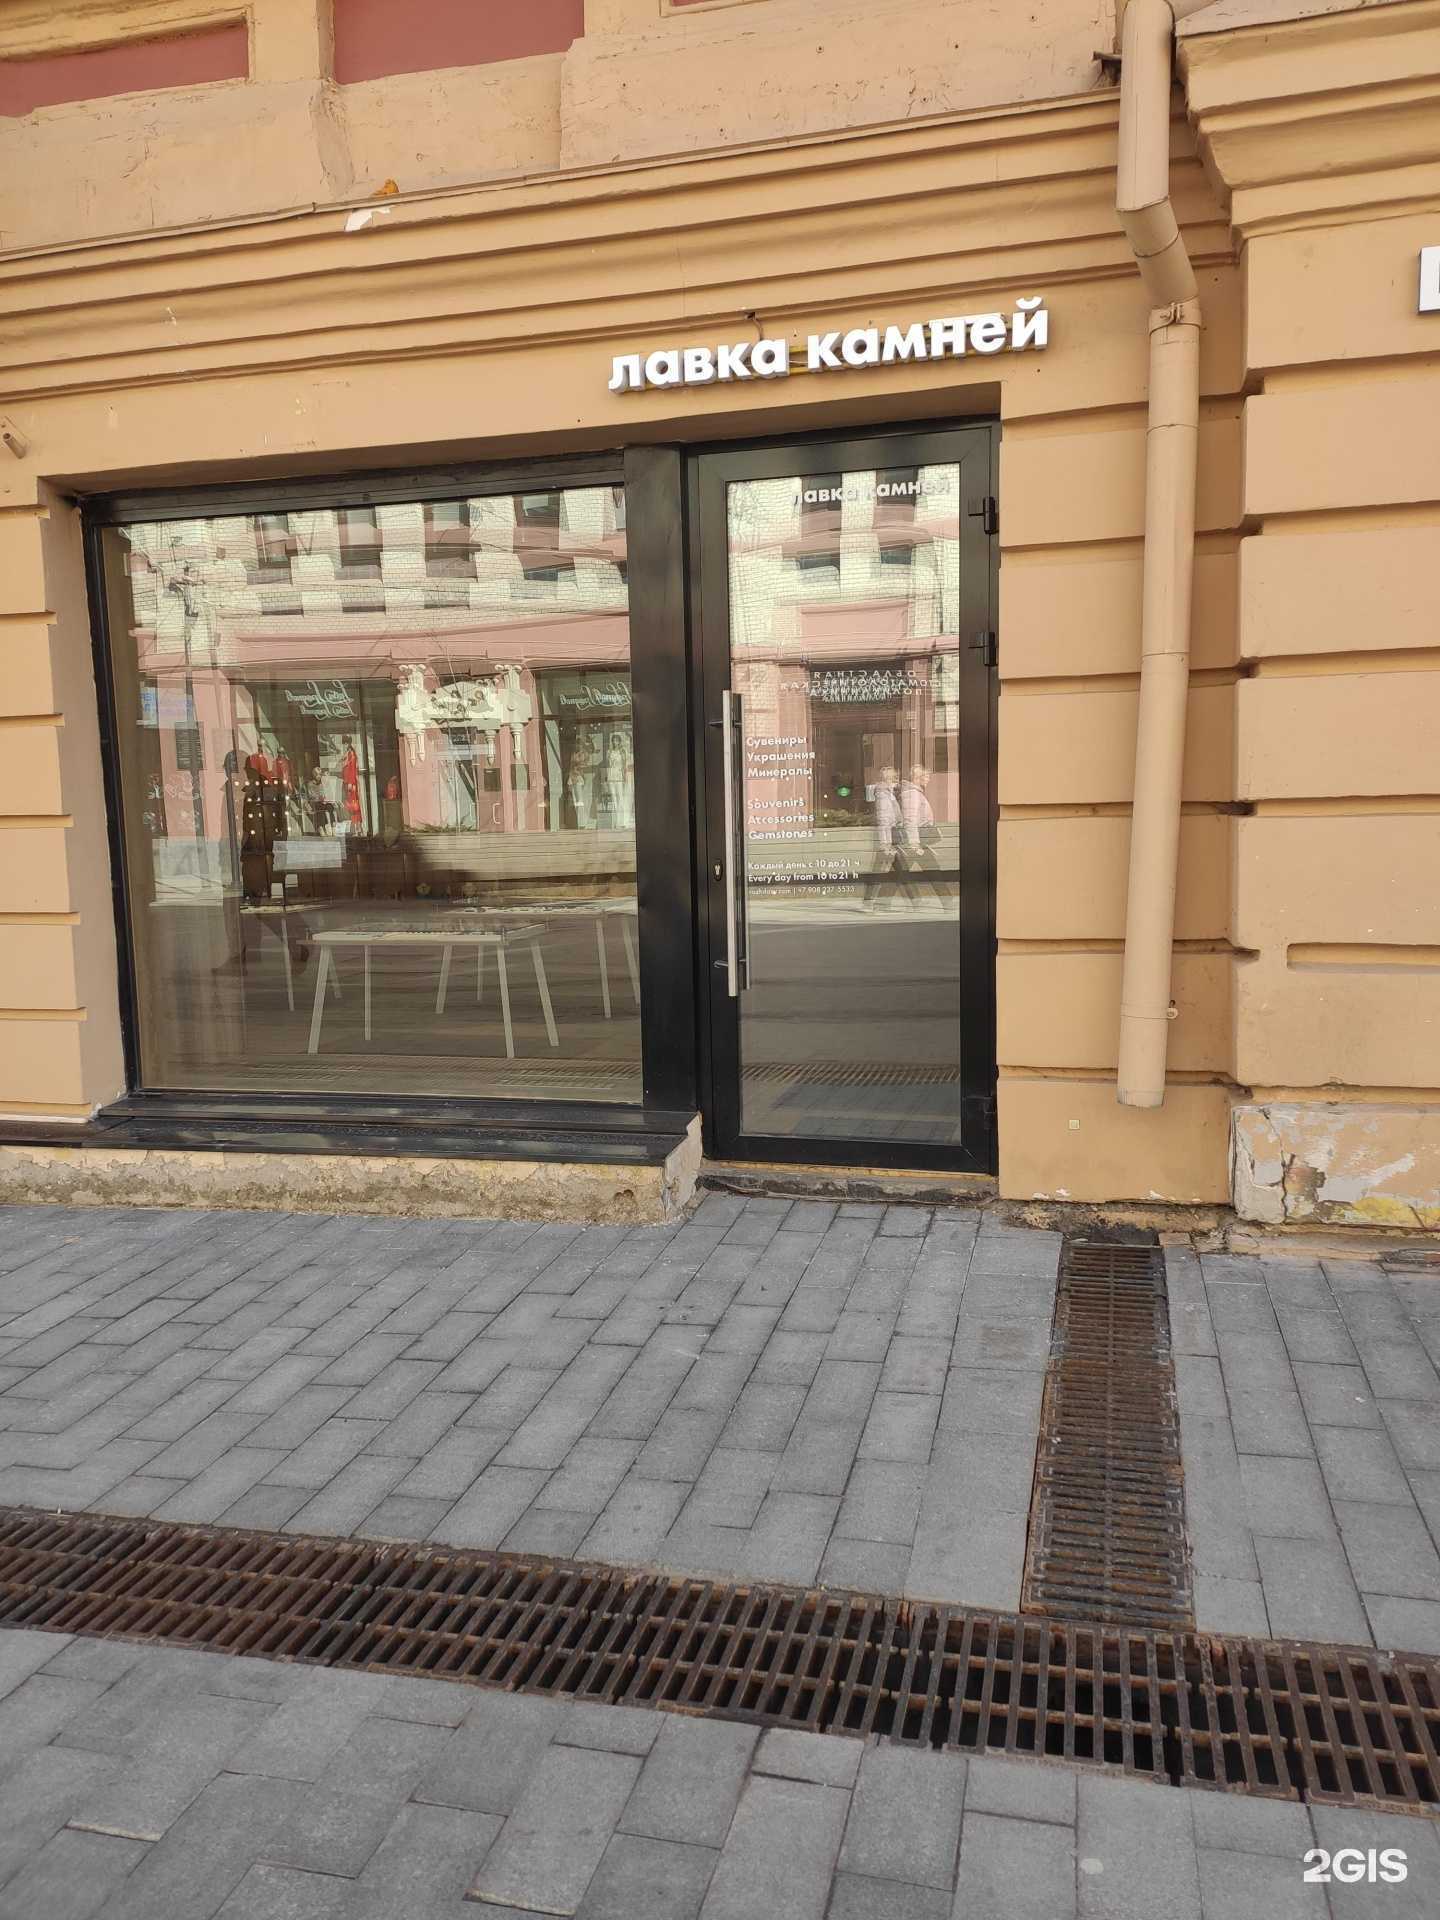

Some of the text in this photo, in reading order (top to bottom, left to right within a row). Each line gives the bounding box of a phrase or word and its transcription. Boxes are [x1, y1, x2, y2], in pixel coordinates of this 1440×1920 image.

[608, 296, 1049, 393] лавка камней
[746, 736, 808, 748] Сувениры
[747, 751, 815, 764] Украшения
[747, 767, 812, 778] Минералы
[747, 798, 804, 809] Souvenirs
[748, 829, 813, 840] Gemstones
[816, 860, 826, 868] 10
[828, 861, 839, 869] до
[840, 859, 850, 867] 21
[748, 873, 772, 884] Every
[774, 872, 792, 883] day
[793, 872, 814, 881] from
[829, 872, 838, 880] to
[839, 871, 848, 880] 21
